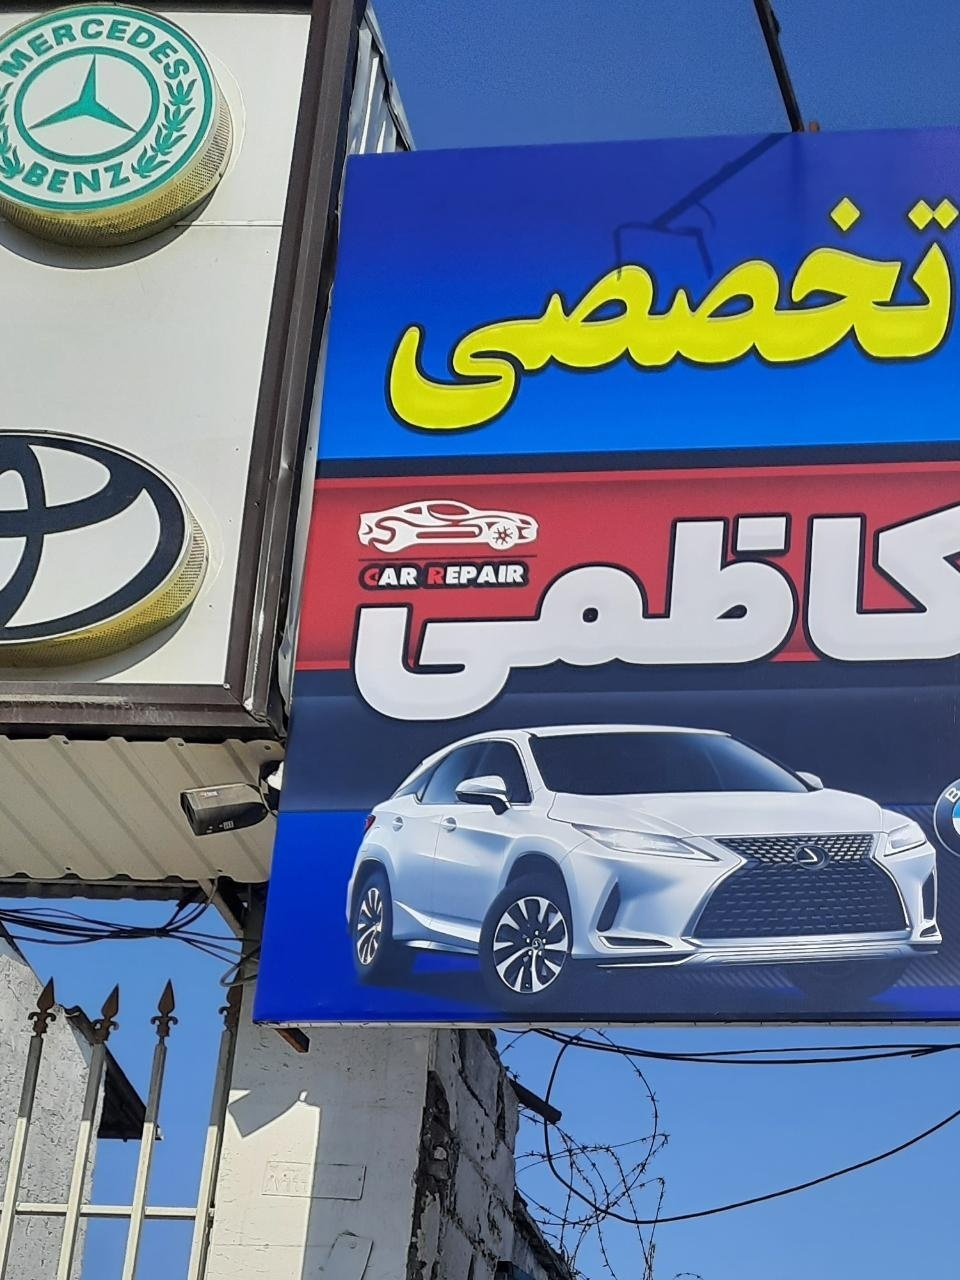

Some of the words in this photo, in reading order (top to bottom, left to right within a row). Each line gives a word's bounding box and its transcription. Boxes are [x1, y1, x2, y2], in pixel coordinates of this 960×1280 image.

[1, 18, 191, 80] MERCEDES
[22, 161, 131, 195] BENZ
[389, 197, 960, 430] تخصصی
[364, 567, 418, 587] CAR
[427, 564, 525, 586] REPAIR
